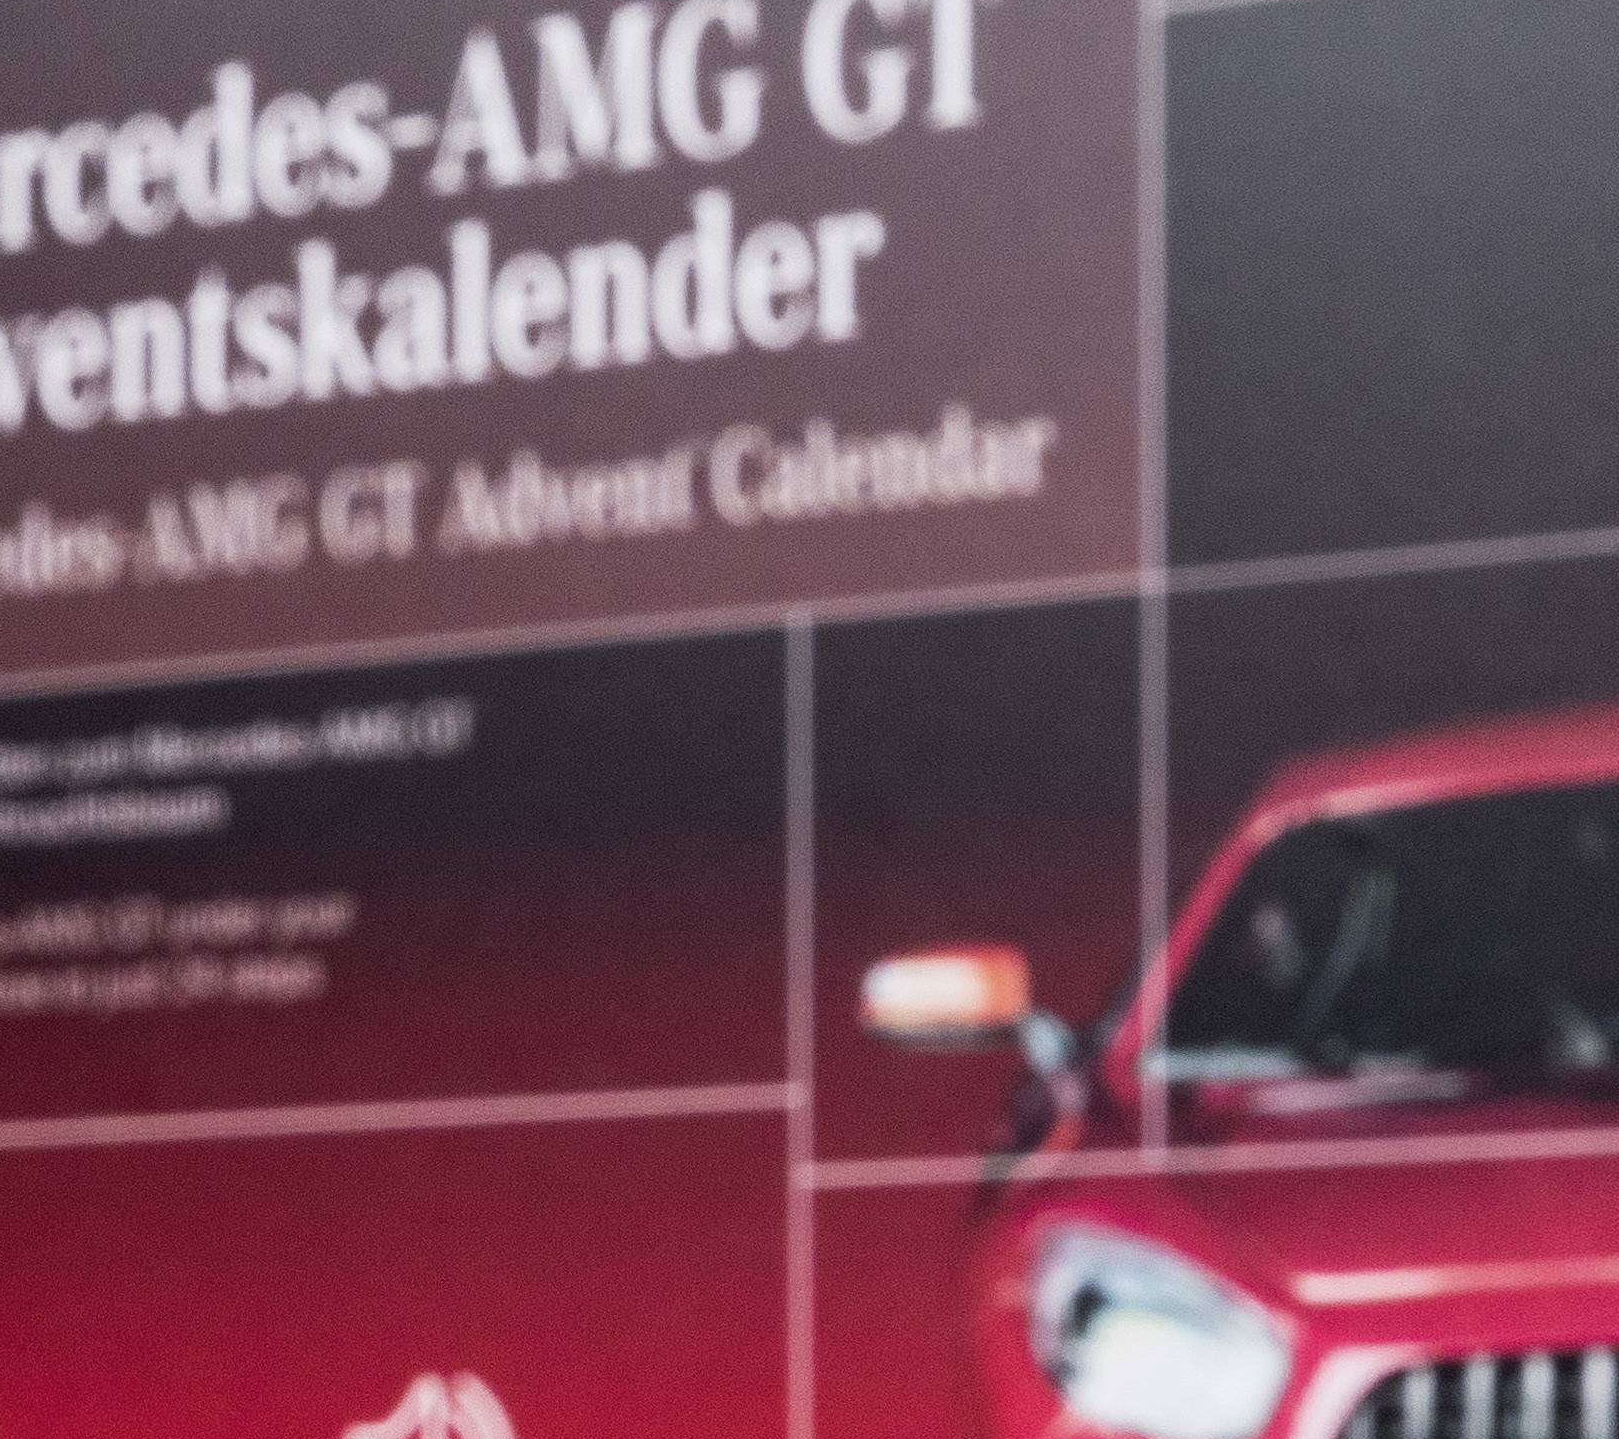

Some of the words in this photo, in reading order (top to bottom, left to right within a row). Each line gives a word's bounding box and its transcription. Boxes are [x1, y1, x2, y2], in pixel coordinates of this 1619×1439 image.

[317, 461, 426, 562] GT
[437, 447, 702, 554] Advent
[709, 399, 1058, 528] Calendar
